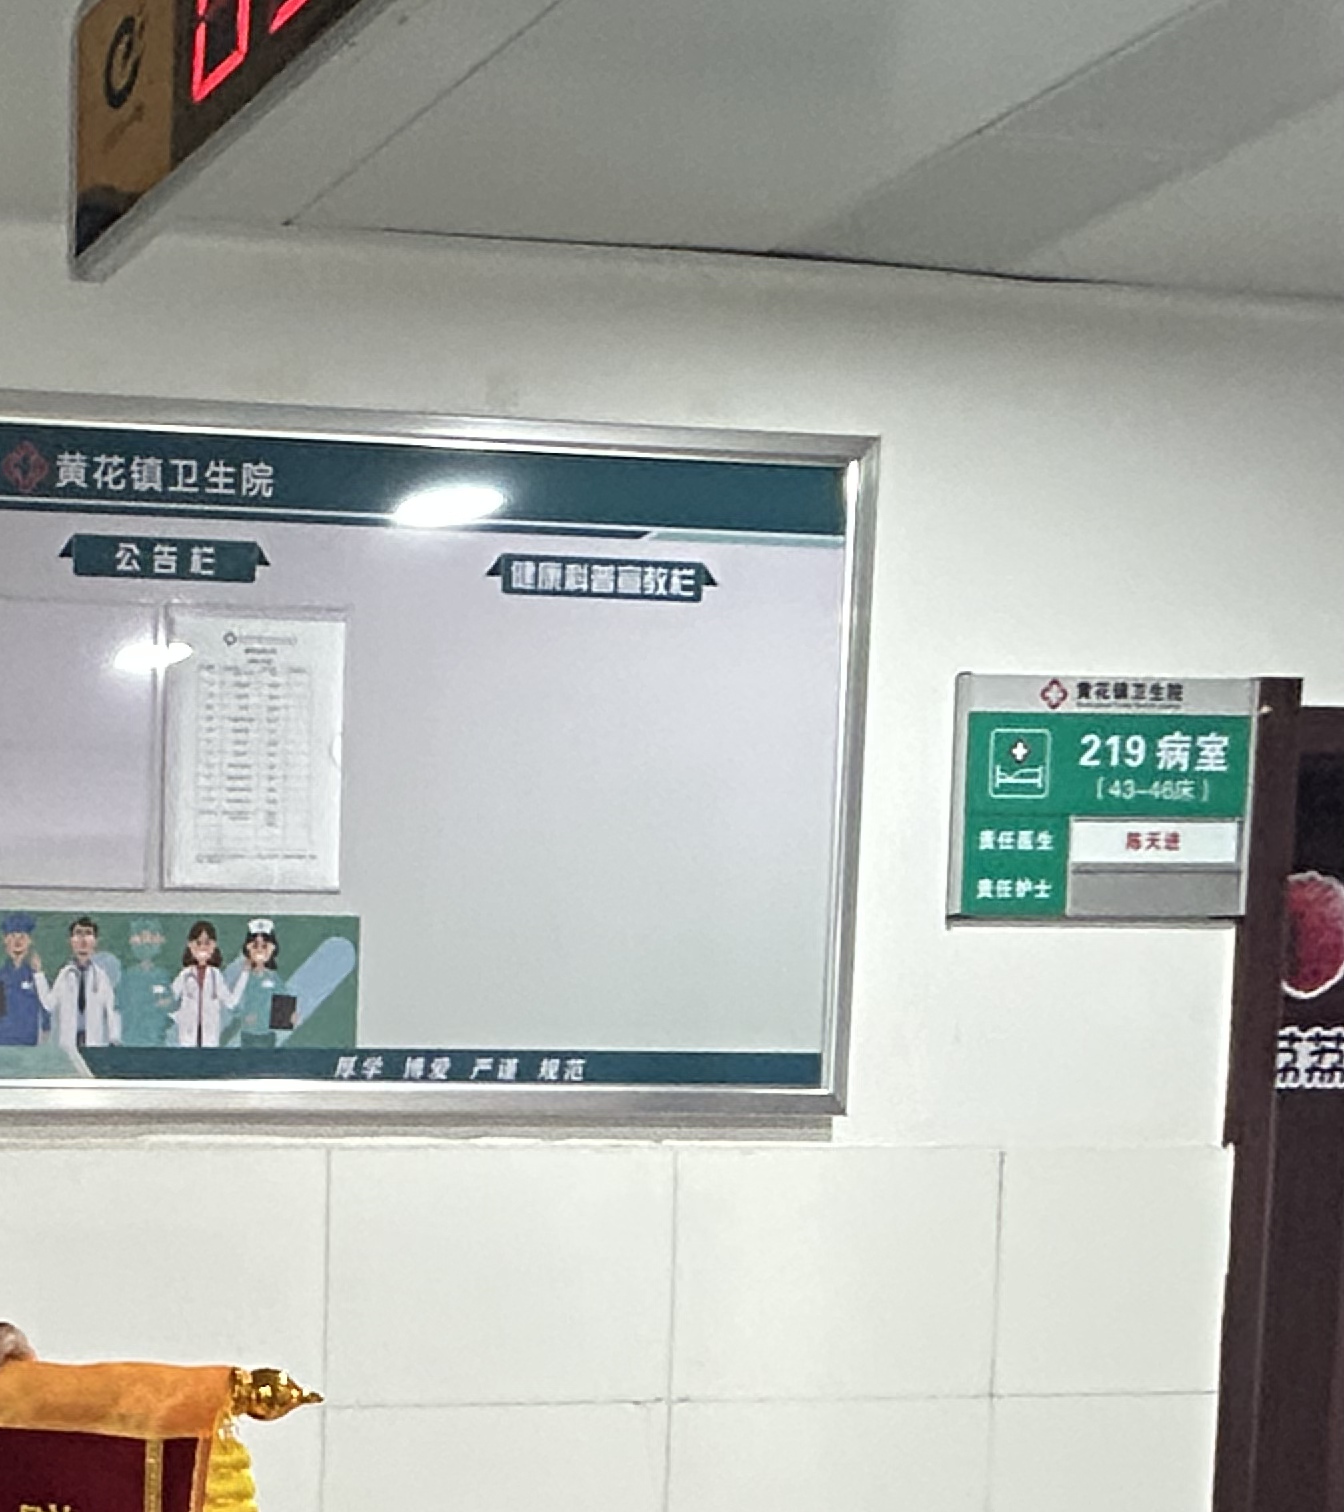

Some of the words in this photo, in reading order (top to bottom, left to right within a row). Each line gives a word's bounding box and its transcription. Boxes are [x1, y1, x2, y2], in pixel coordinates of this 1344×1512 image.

[55, 451, 274, 498] 黄花镇卫生院
[115, 543, 216, 575] 公告栏
[511, 560, 696, 597] 健康科普宣教栏
[1076, 682, 1184, 702] 黄花镇卫生院
[1079, 734, 1146, 768] 219
[1155, 730, 1230, 772] 病室
[978, 829, 1055, 851] 责任医生
[976, 877, 1053, 900] 责任护士
[334, 1055, 383, 1079] 厚学
[403, 1056, 451, 1080] 博爱
[469, 1057, 519, 1080] 严谨
[537, 1058, 586, 1082] 规范
